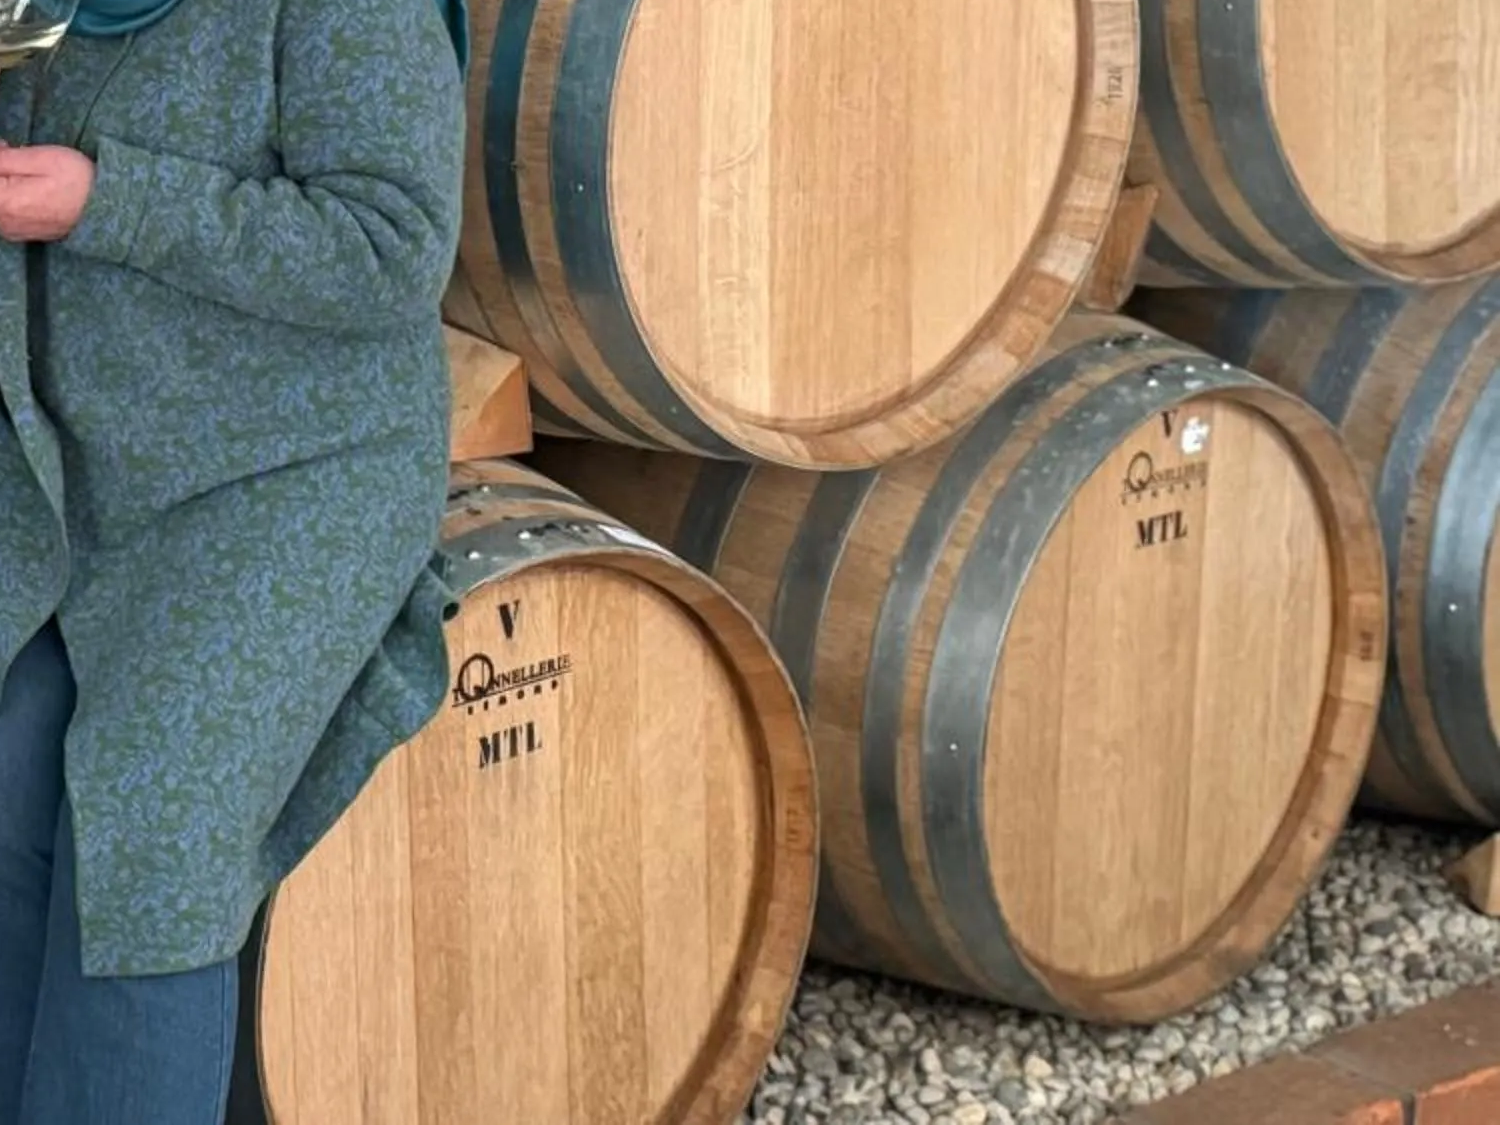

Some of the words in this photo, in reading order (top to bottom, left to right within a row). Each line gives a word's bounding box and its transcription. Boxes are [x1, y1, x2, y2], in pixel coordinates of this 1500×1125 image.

[1134, 510, 1189, 550] MTL
[498, 598, 521, 640] V
[478, 721, 543, 770] MTL
